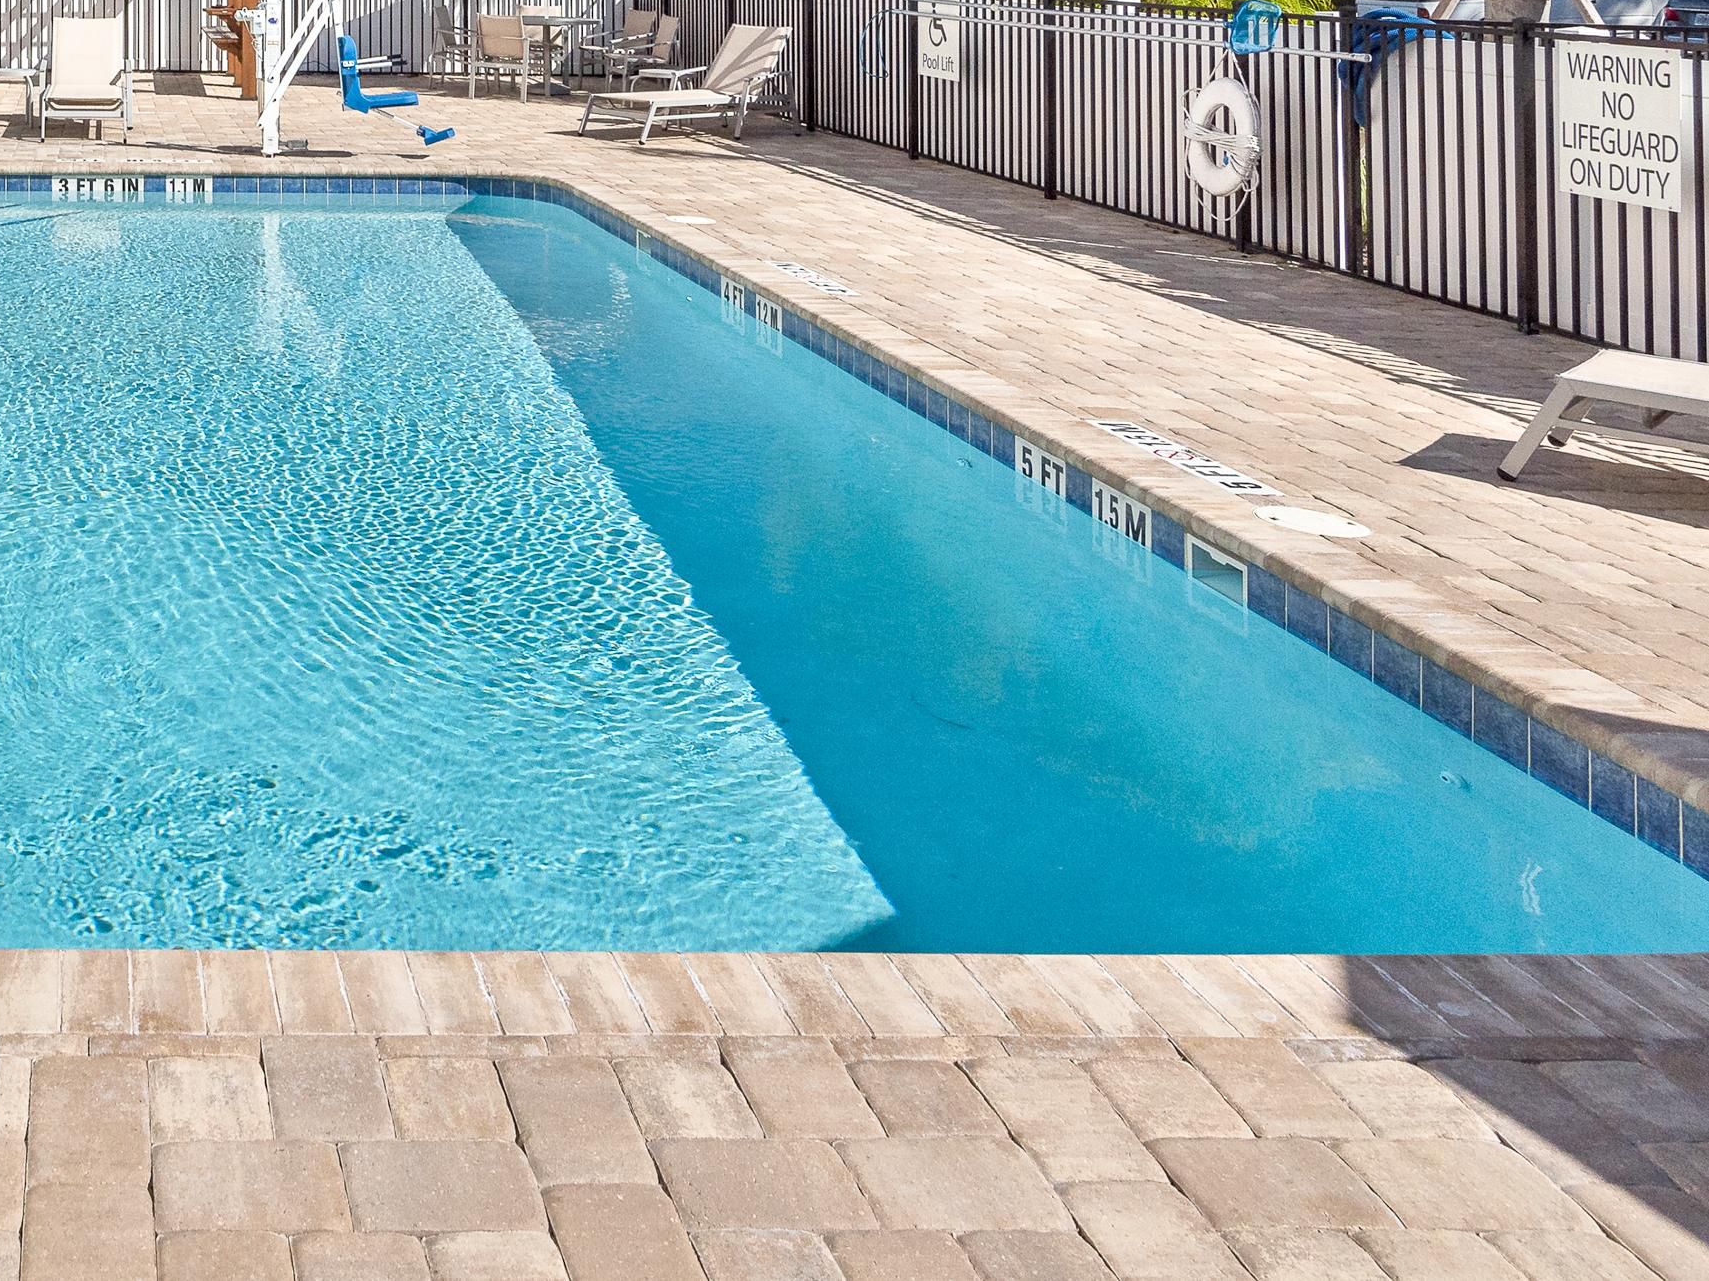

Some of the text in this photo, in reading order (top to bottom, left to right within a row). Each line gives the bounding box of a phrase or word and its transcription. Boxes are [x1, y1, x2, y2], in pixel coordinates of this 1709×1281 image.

[922, 53, 954, 73] Pool Lift
[1567, 52, 1670, 88] WARNING
[1602, 91, 1634, 121] NO
[1563, 121, 1679, 164] LIFEGUARD
[58, 178, 139, 192] 3 FT 6 IN
[193, 179, 206, 192] M
[1570, 158, 1670, 199] ON DUTY
[723, 281, 744, 311] 4 FT
[1021, 445, 1065, 497] 5 FT
[1095, 488, 1147, 547] 1.5 M
